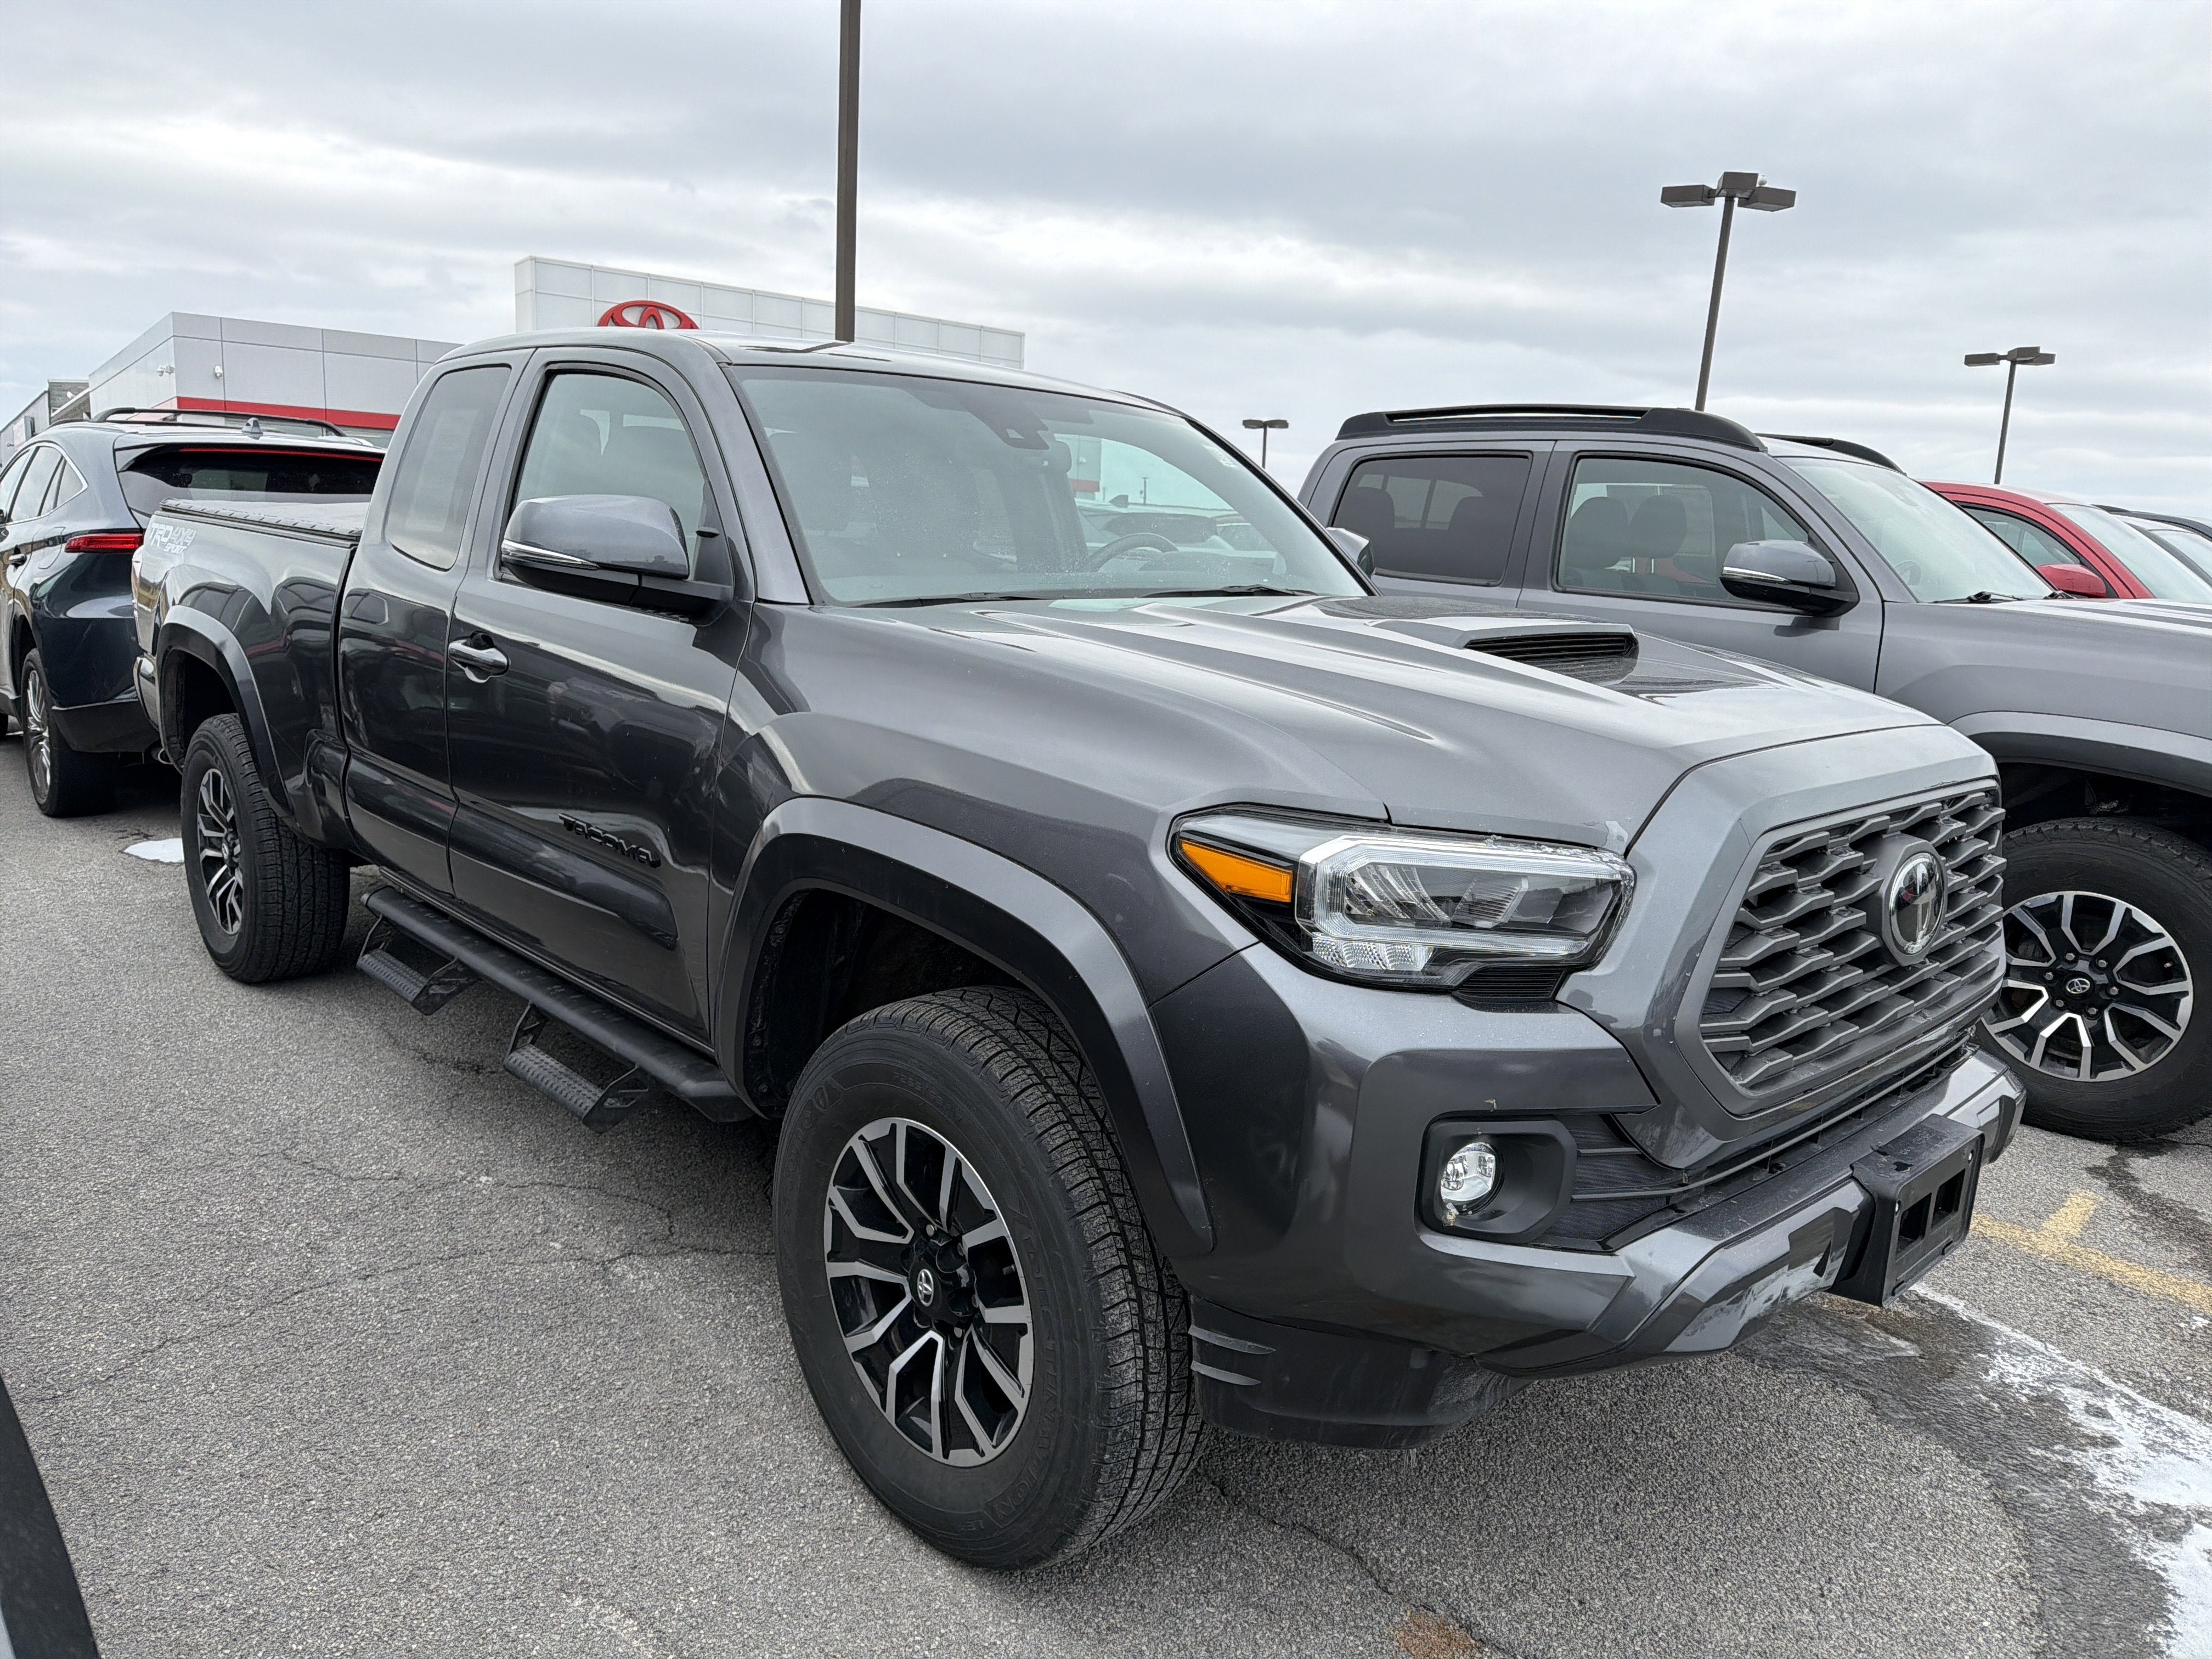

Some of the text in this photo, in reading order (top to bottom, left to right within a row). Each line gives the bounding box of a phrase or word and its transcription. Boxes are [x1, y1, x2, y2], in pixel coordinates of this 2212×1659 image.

[150, 523, 173, 546] TRD
[163, 543, 187, 554] SPORT
[558, 813, 661, 868] TACOMA
